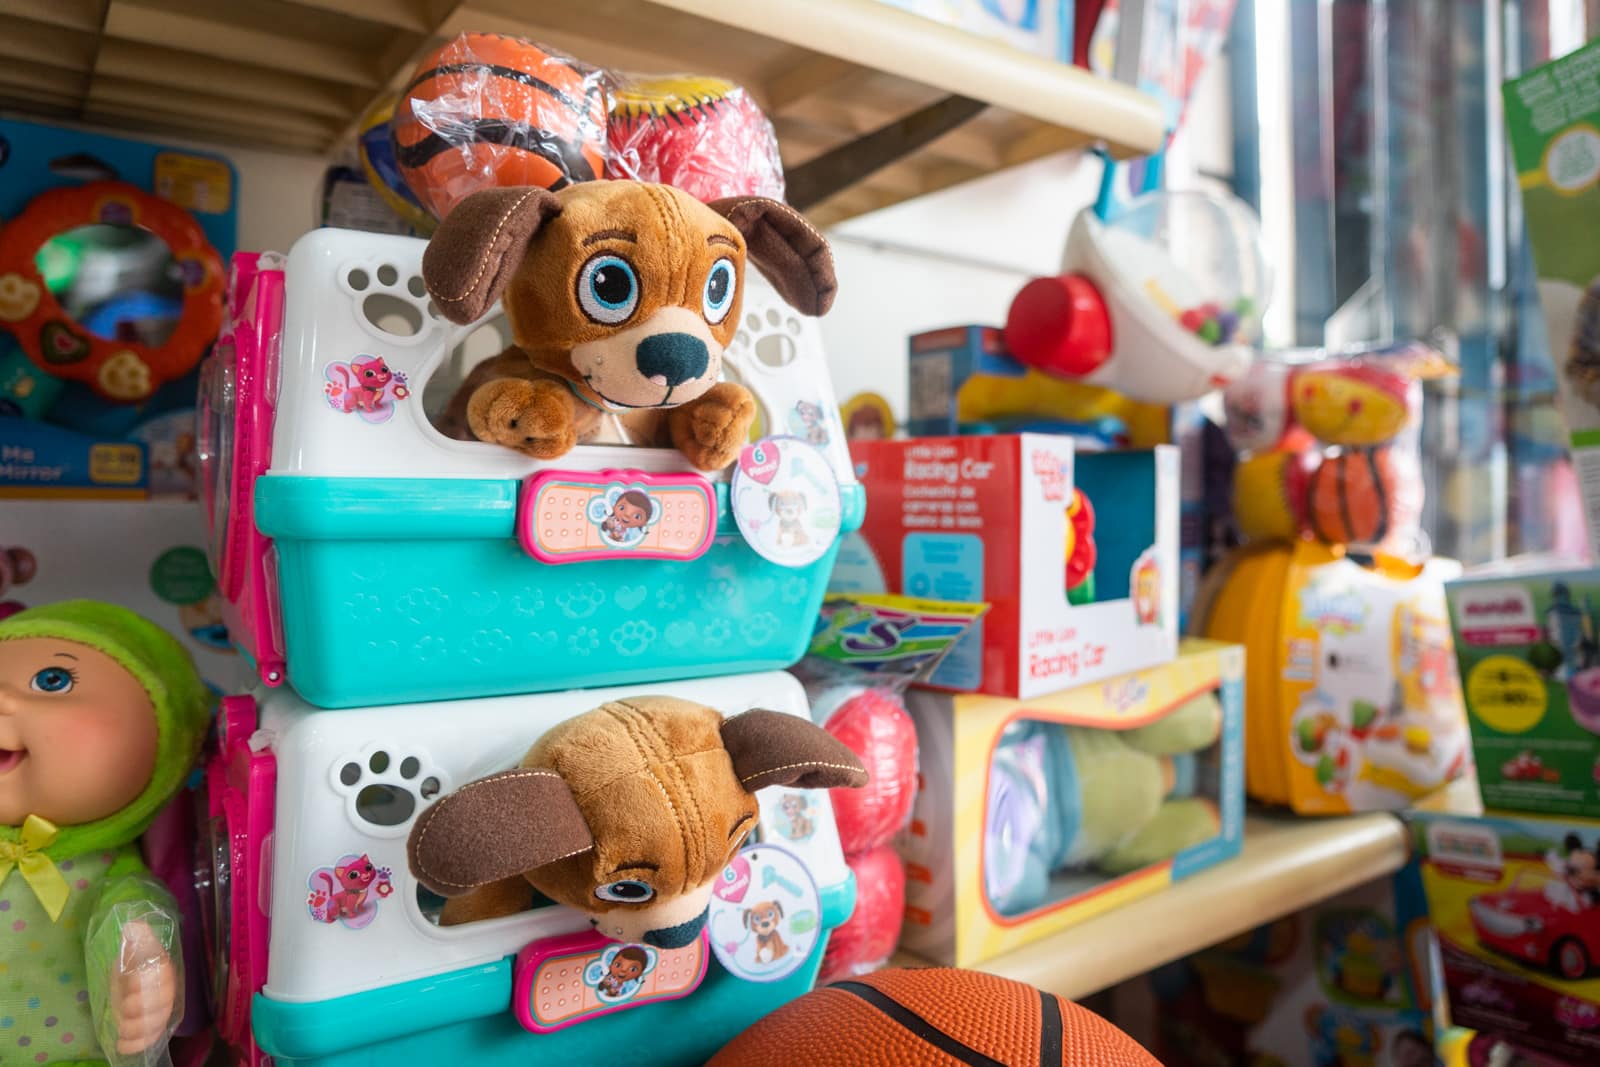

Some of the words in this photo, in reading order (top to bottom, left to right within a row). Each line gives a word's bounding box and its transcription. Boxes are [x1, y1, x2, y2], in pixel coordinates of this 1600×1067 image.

[754, 448, 765, 463] 6
[903, 459, 958, 484] Racing
[961, 457, 995, 480] Car
[1029, 652, 1079, 679] Racing
[1083, 643, 1107, 668] Car
[724, 867, 736, 882] 6
